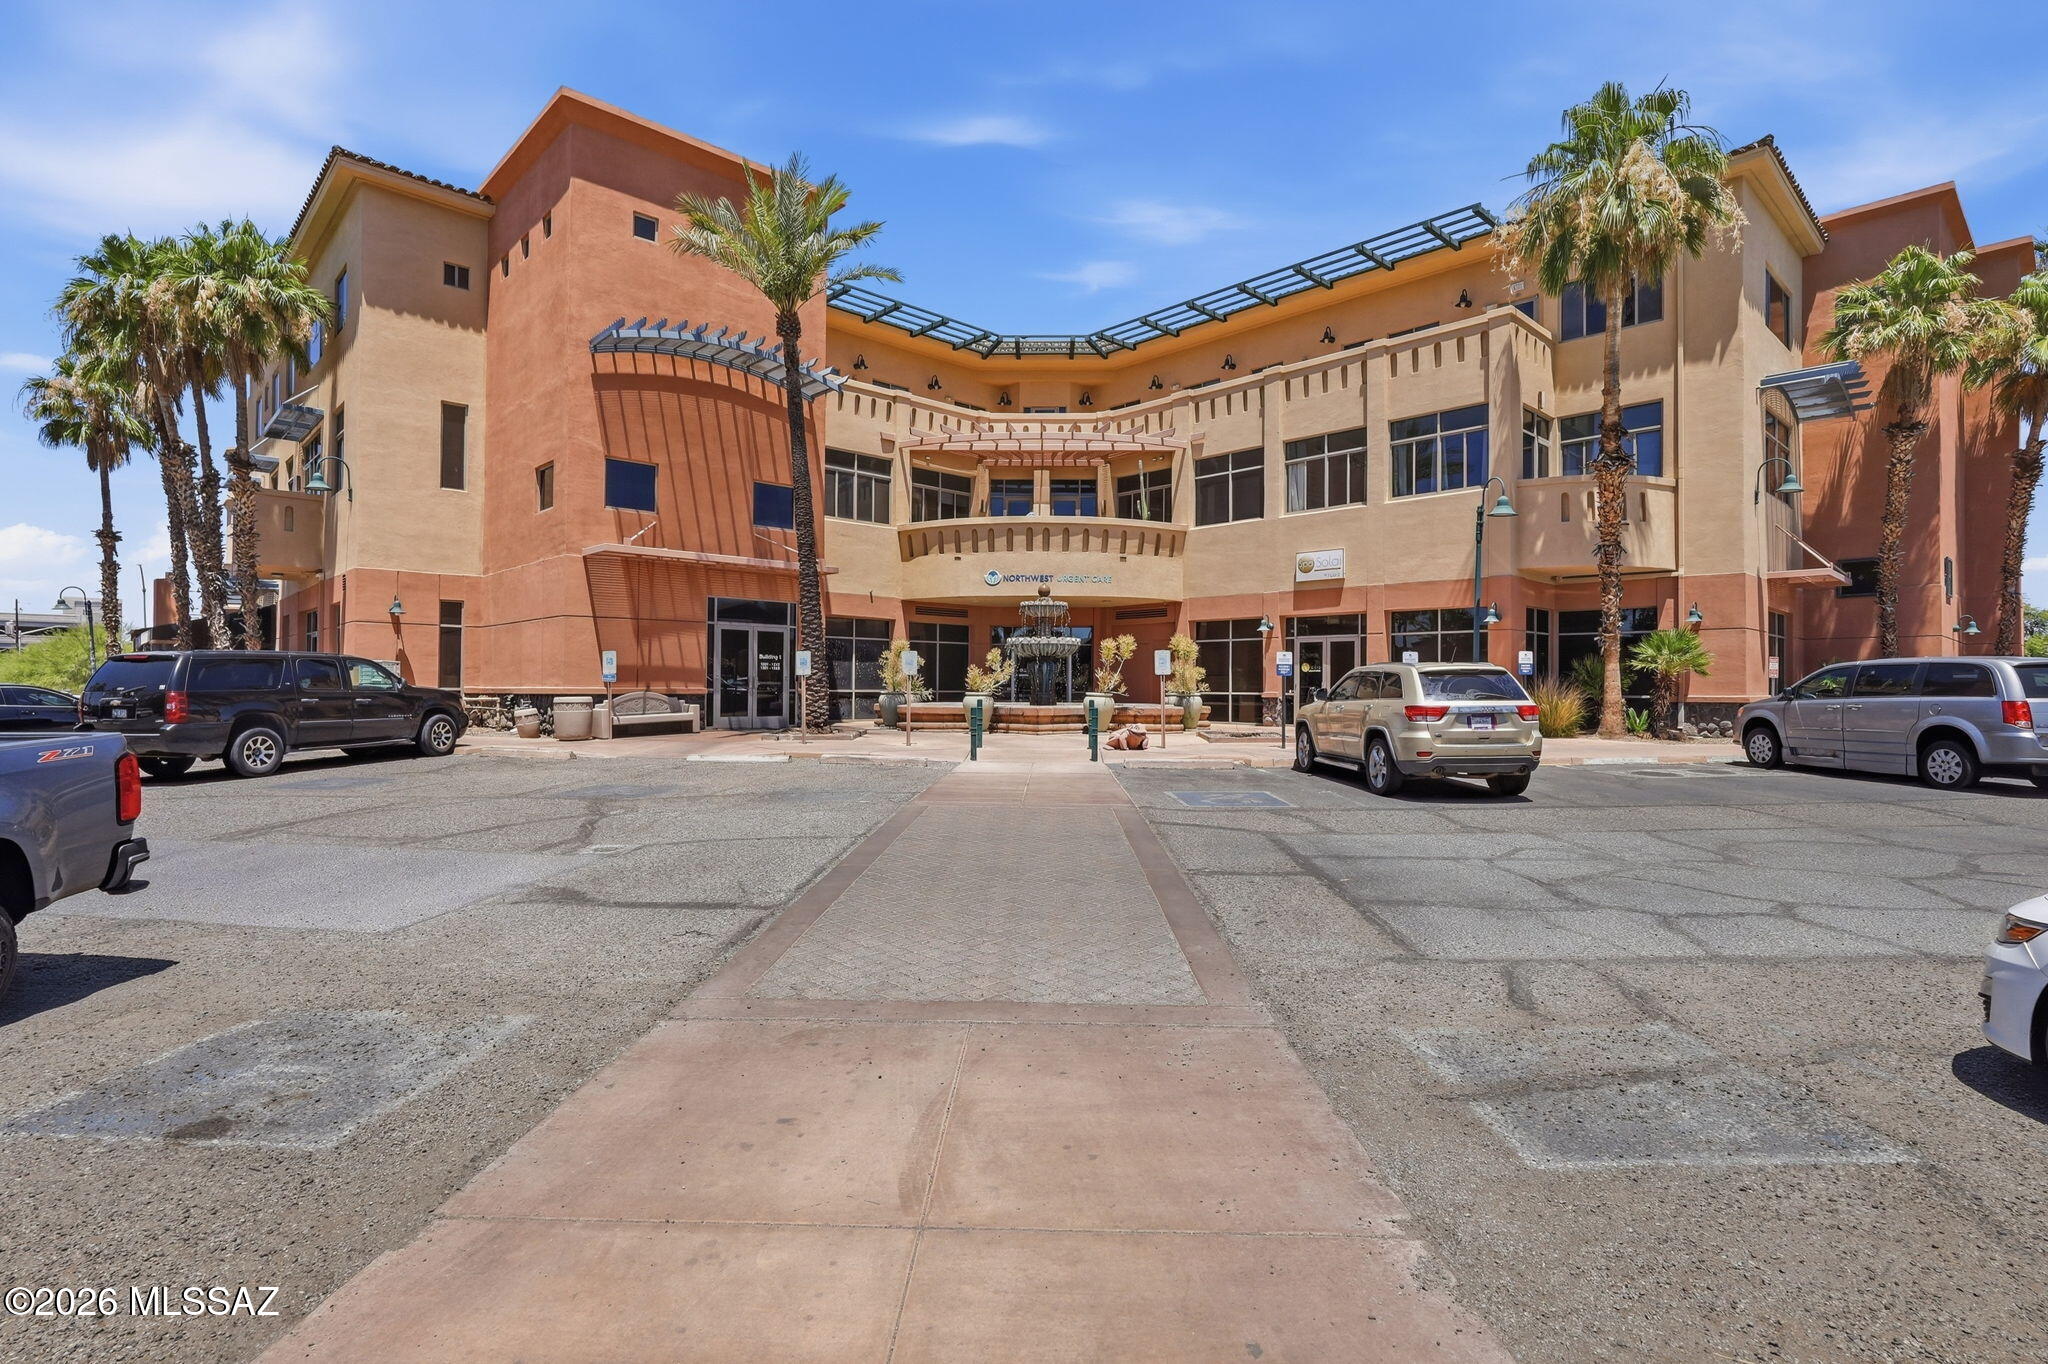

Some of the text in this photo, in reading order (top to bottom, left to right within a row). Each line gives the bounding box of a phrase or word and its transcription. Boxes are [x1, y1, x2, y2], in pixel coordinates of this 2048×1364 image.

[1003, 574, 1112, 584] NORTHWEST URGENT CARE
[37, 745, 95, 763] Z71
